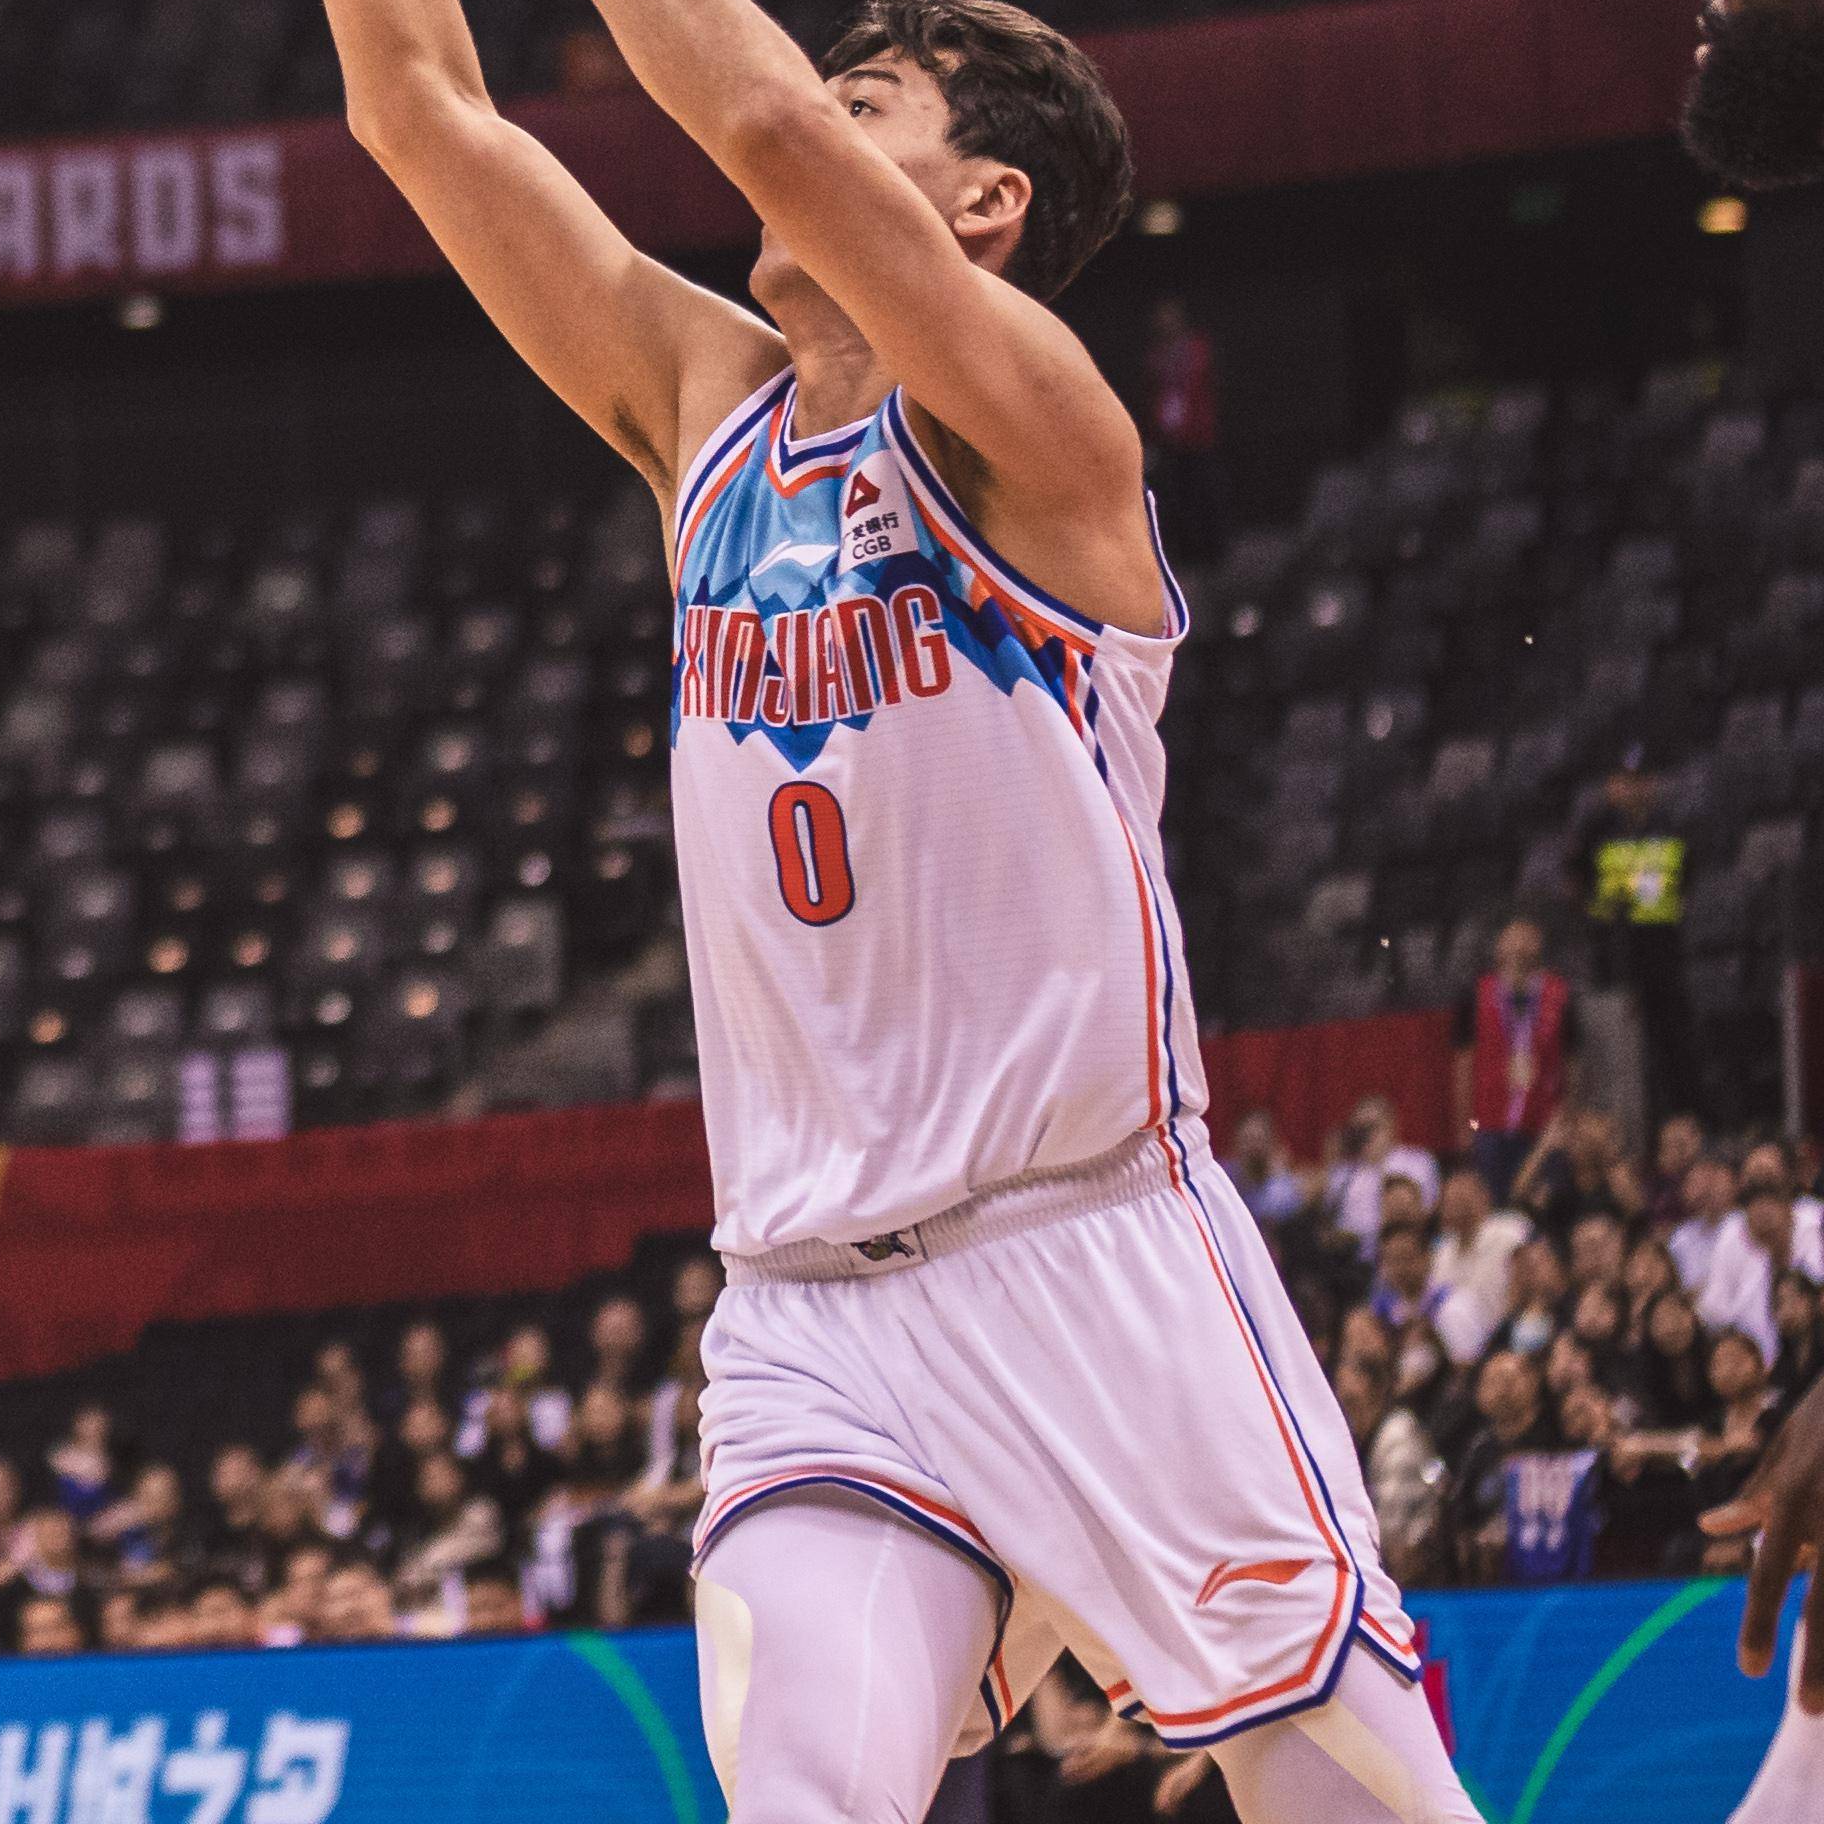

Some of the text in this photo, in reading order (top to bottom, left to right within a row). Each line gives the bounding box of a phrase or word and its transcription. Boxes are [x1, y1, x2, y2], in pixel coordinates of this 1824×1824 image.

[853, 535, 892, 560] CGB
[681, 584, 952, 726] XINJIANG
[768, 781, 855, 927] 0
